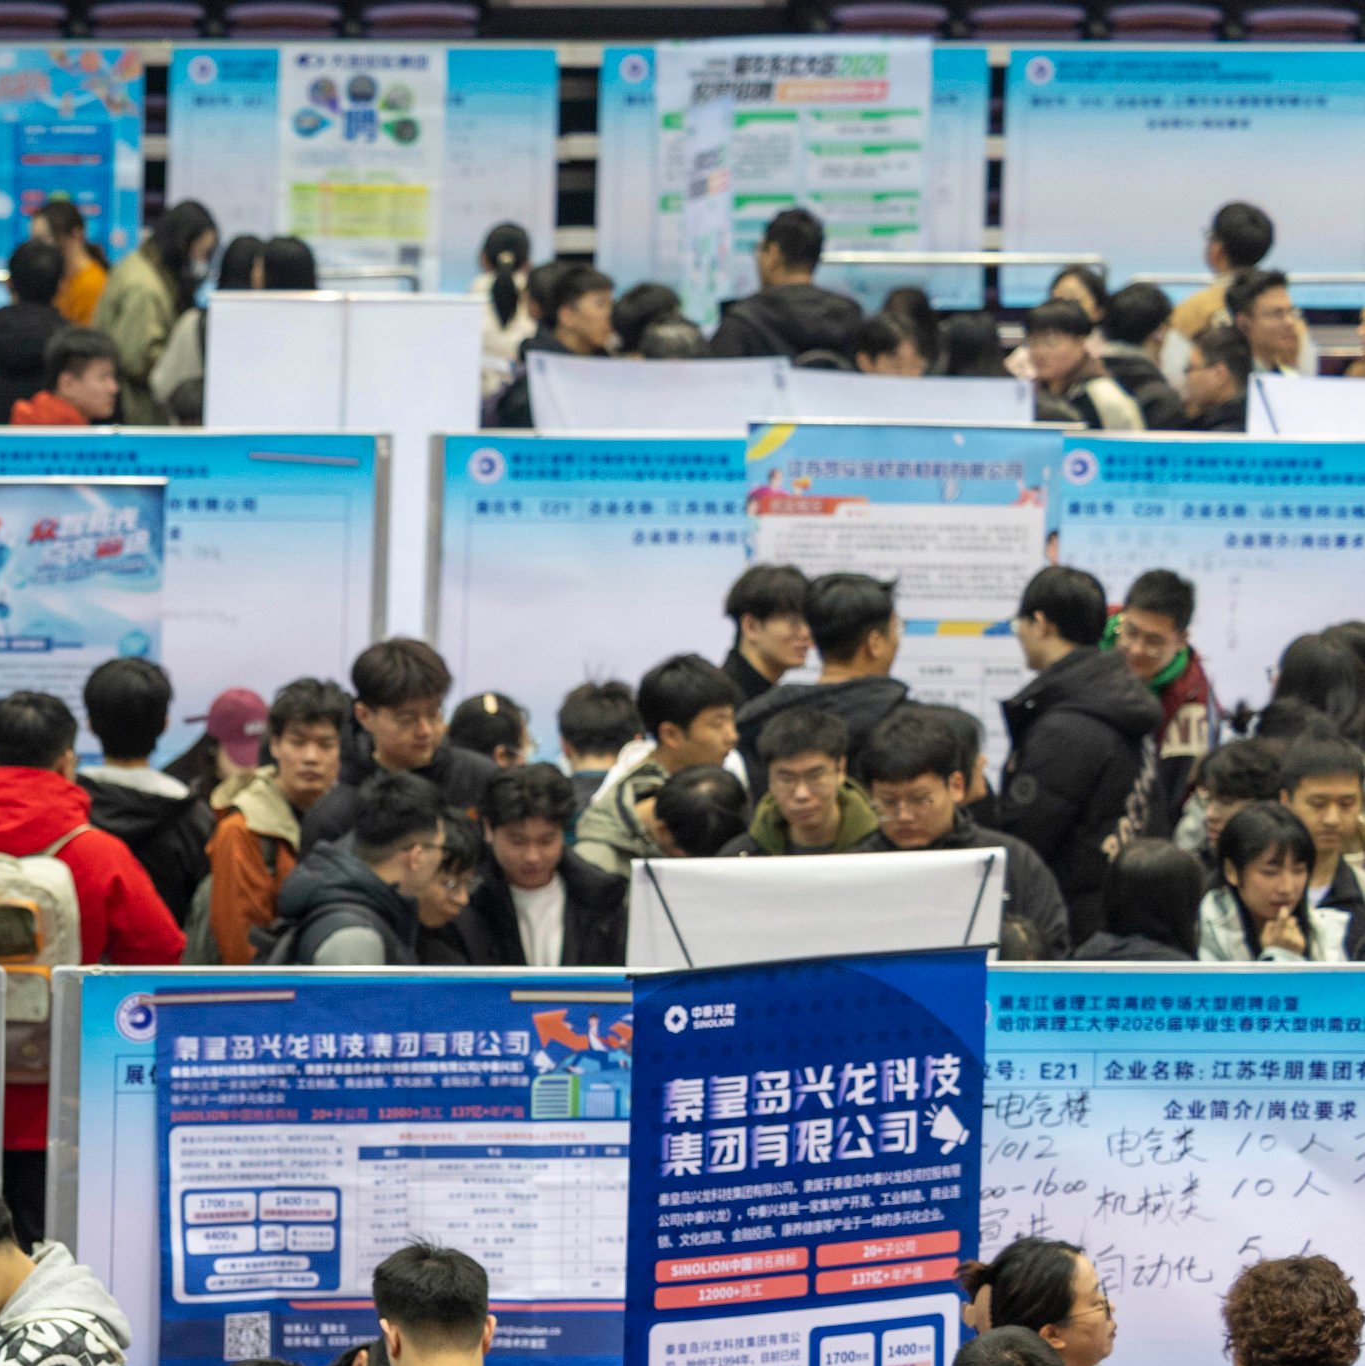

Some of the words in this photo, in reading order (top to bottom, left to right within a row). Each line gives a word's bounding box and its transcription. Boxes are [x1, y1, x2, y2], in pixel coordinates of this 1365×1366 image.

[690, 1003, 737, 1019] 中秦兴龙
[998, 995, 1301, 1013] 黑龙江省理工类高校专场大型招聘会暨
[692, 1018, 736, 1030] SINOLION
[997, 1015, 1365, 1033] 哈尔滨理工大学2026届毕业生春季大型供需双
[1039, 1063, 1079, 1080] E21
[661, 1052, 962, 1126] 秦皇岛兴龙科技
[1163, 1100, 1357, 1121] 企业简介/岗位要求
[660, 1108, 920, 1178] 集团有限公司
[862, 1240, 918, 1259] 20+子公司
[697, 1283, 764, 1303] 12000+员工
